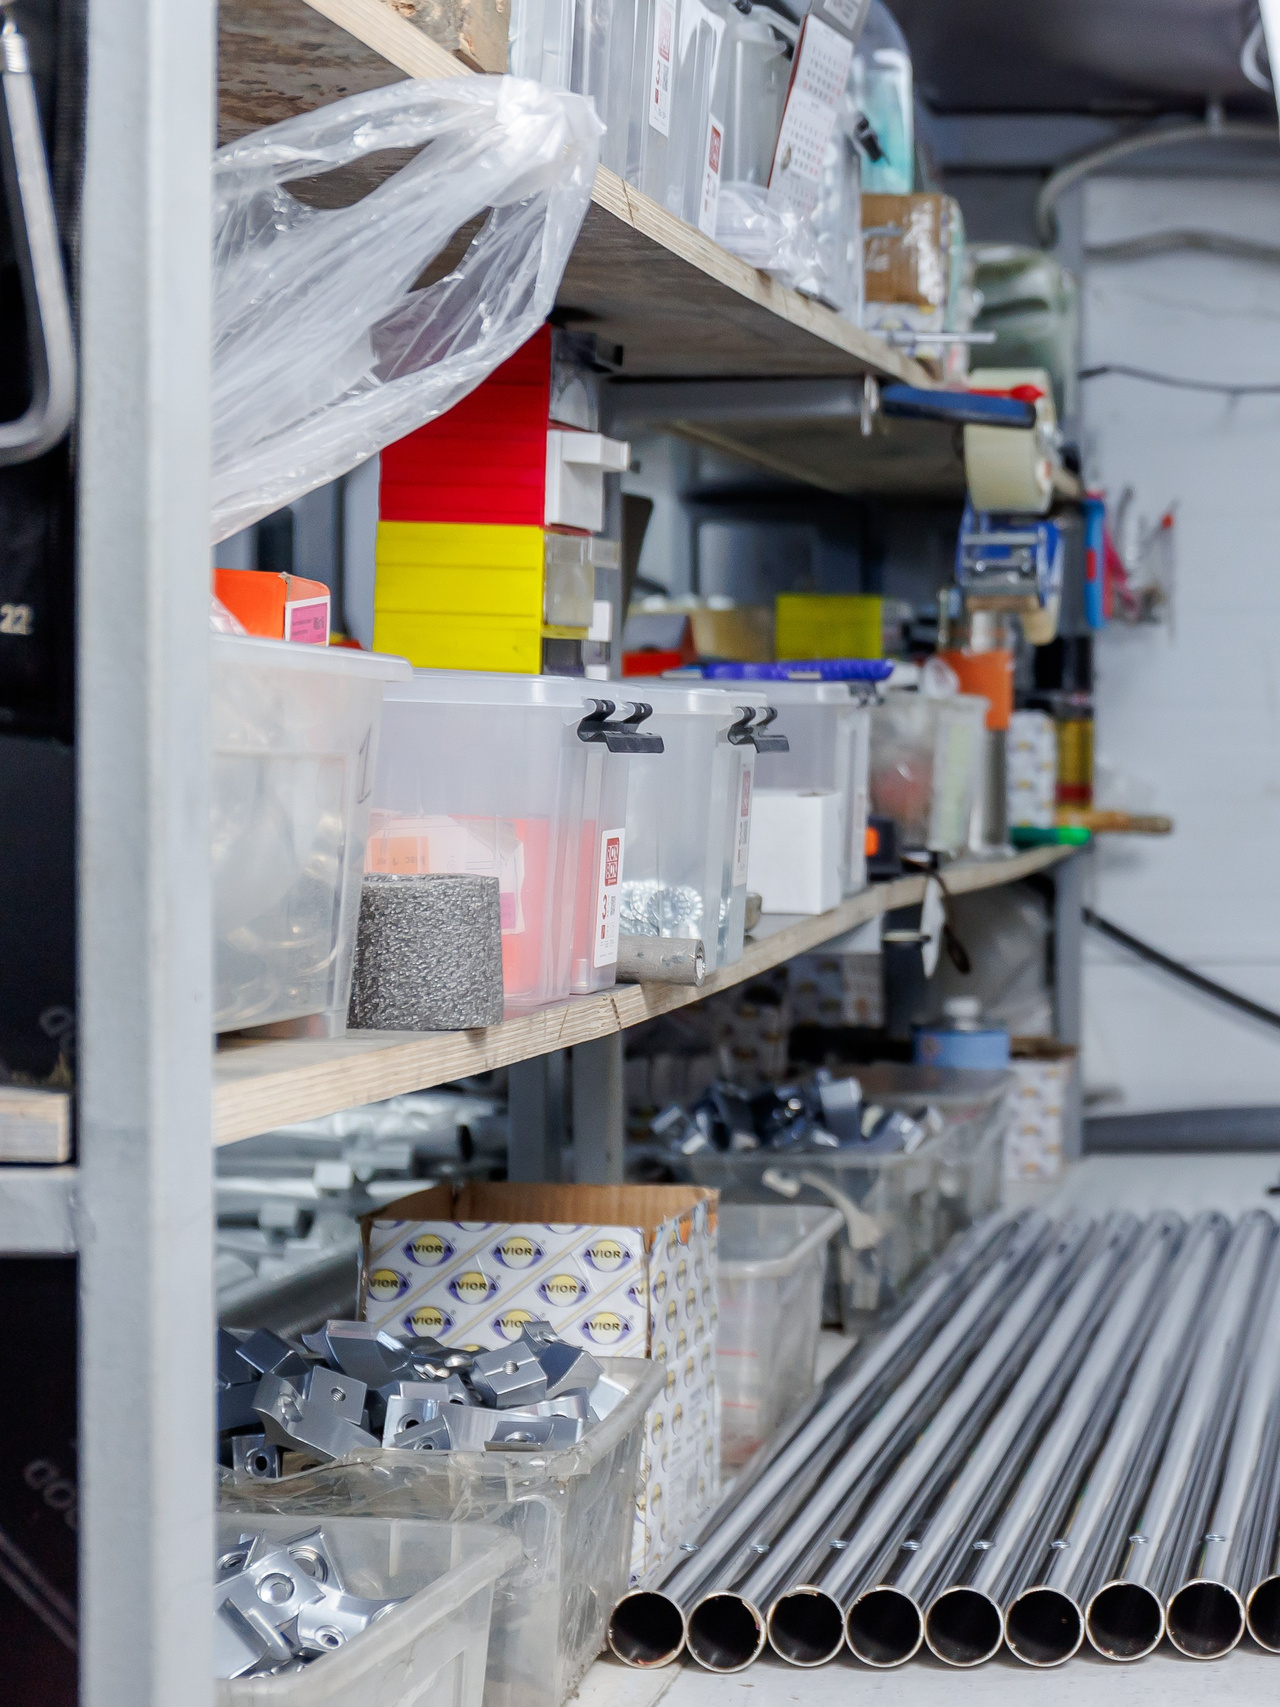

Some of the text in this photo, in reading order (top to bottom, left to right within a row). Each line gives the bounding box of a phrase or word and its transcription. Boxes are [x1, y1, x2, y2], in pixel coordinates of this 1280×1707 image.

[405, 1243, 453, 1254] AVIORA
[494, 1246, 542, 1257] AVIORA
[583, 1249, 631, 1259] AVIORA
[369, 1279, 410, 1289] VIORA
[448, 1281, 497, 1292] AVIORA
[539, 1284, 588, 1294] AVIORA
[403, 1316, 452, 1327] AVIORA
[493, 1320, 524, 1329] AVIO
[581, 1321, 630, 1332] AVIORA
